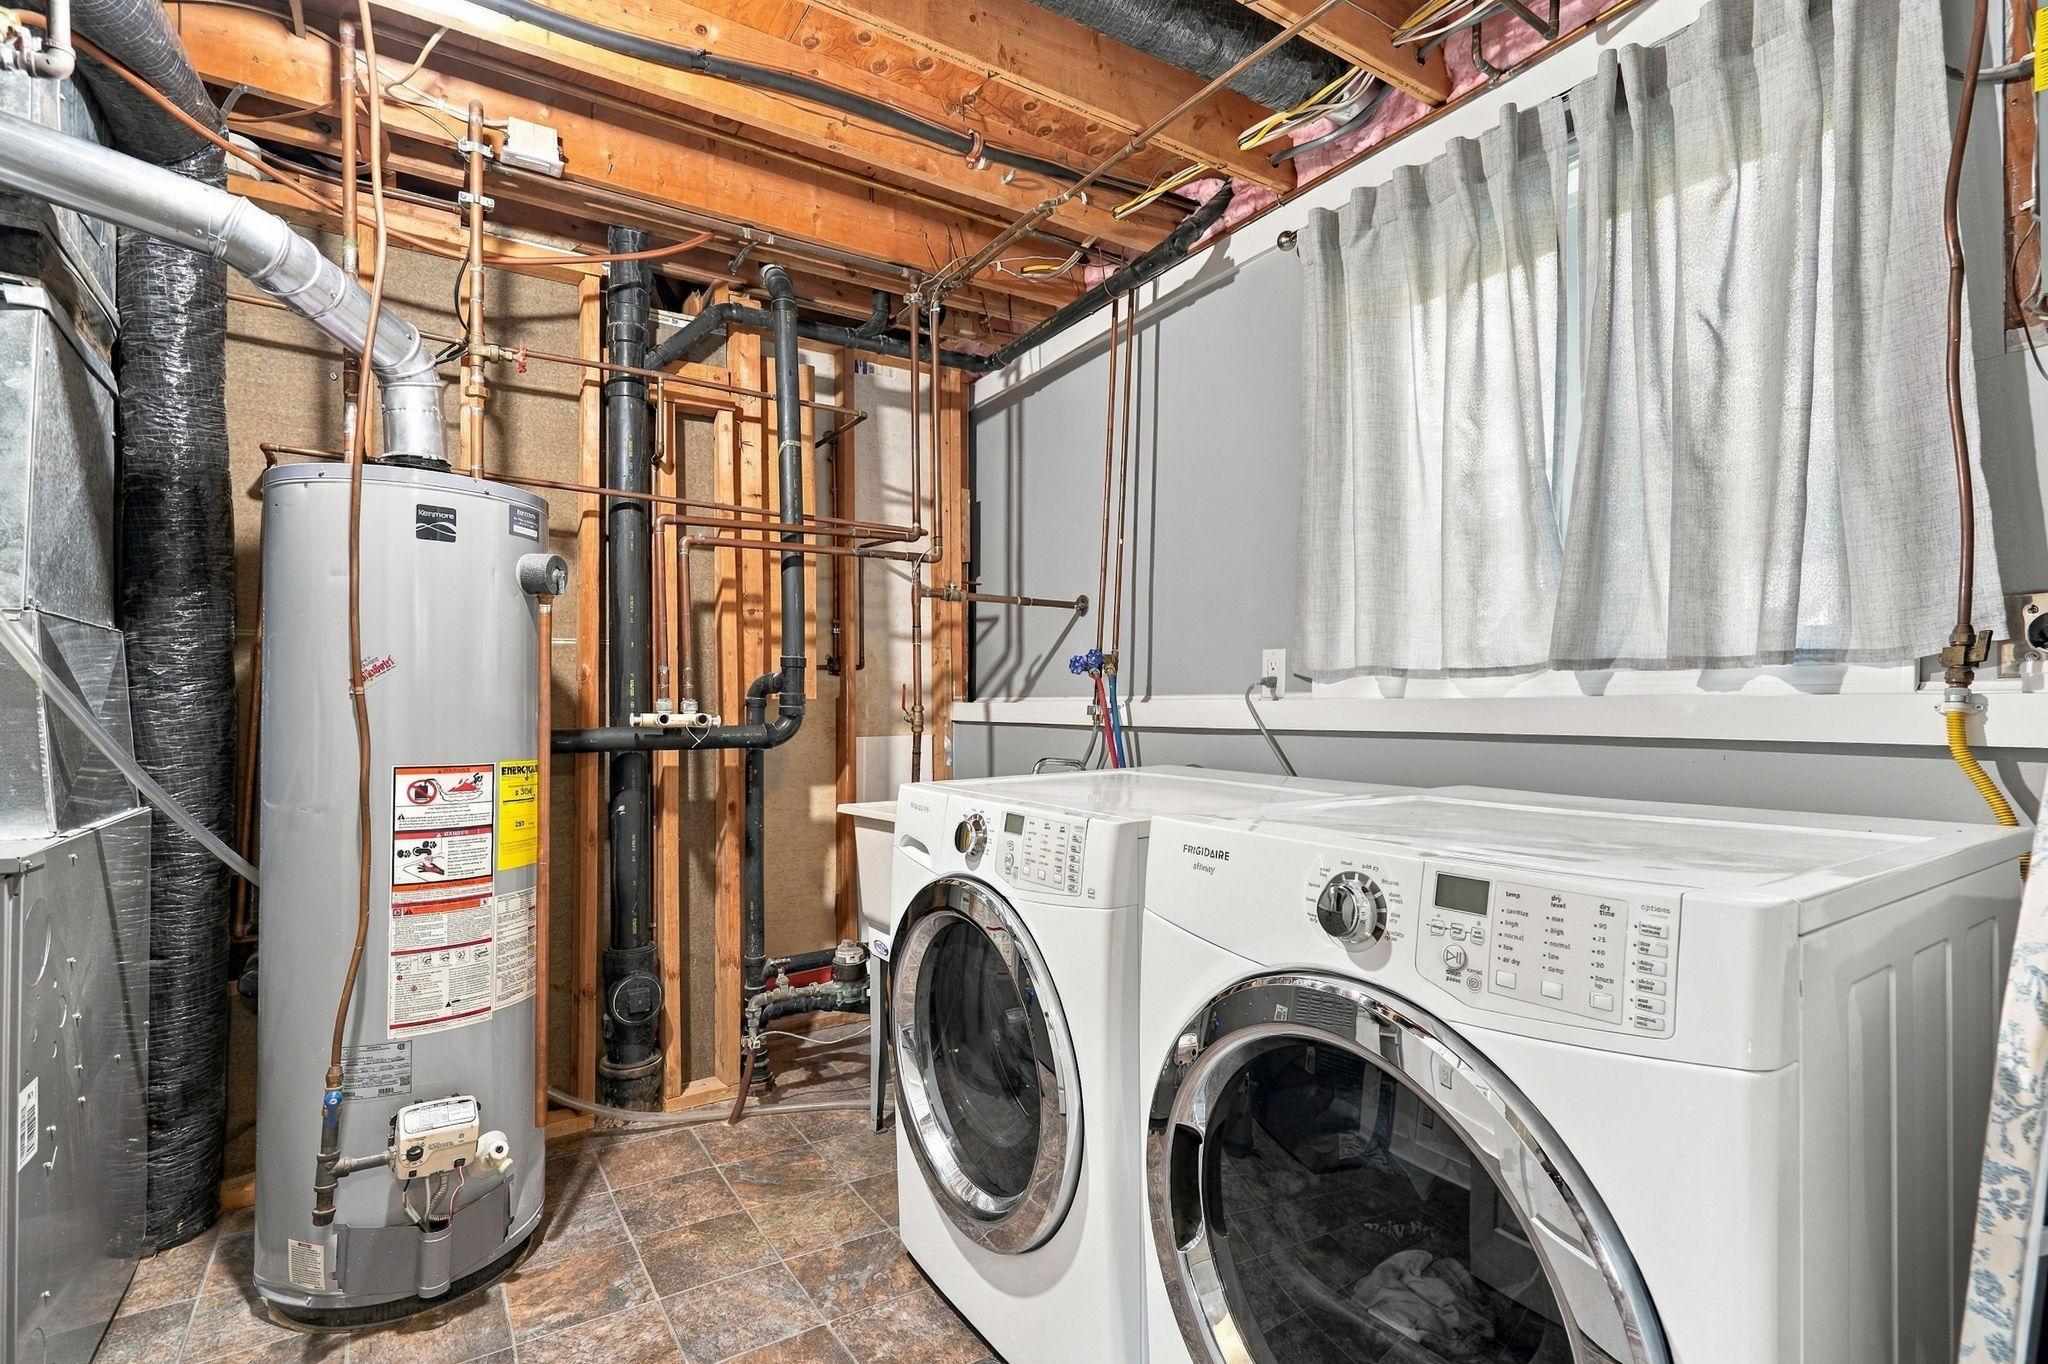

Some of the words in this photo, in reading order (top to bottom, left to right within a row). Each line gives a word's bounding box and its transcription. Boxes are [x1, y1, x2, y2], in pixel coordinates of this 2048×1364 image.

[418, 508, 454, 520] Kenmore
[1182, 843, 1230, 861] FRIGIDAIRE
[1192, 862, 1216, 876] affinity
[1505, 891, 1521, 899] temp
[1551, 895, 1562, 903] dry
[1600, 903, 1611, 911] dry
[1640, 904, 1671, 915] options
[1600, 910, 1615, 918] time
[1505, 920, 1519, 928] high
[1550, 928, 1565, 936] high
[1504, 933, 1525, 941] normal
[1549, 941, 1571, 950] normal
[1548, 965, 1565, 975] damp
